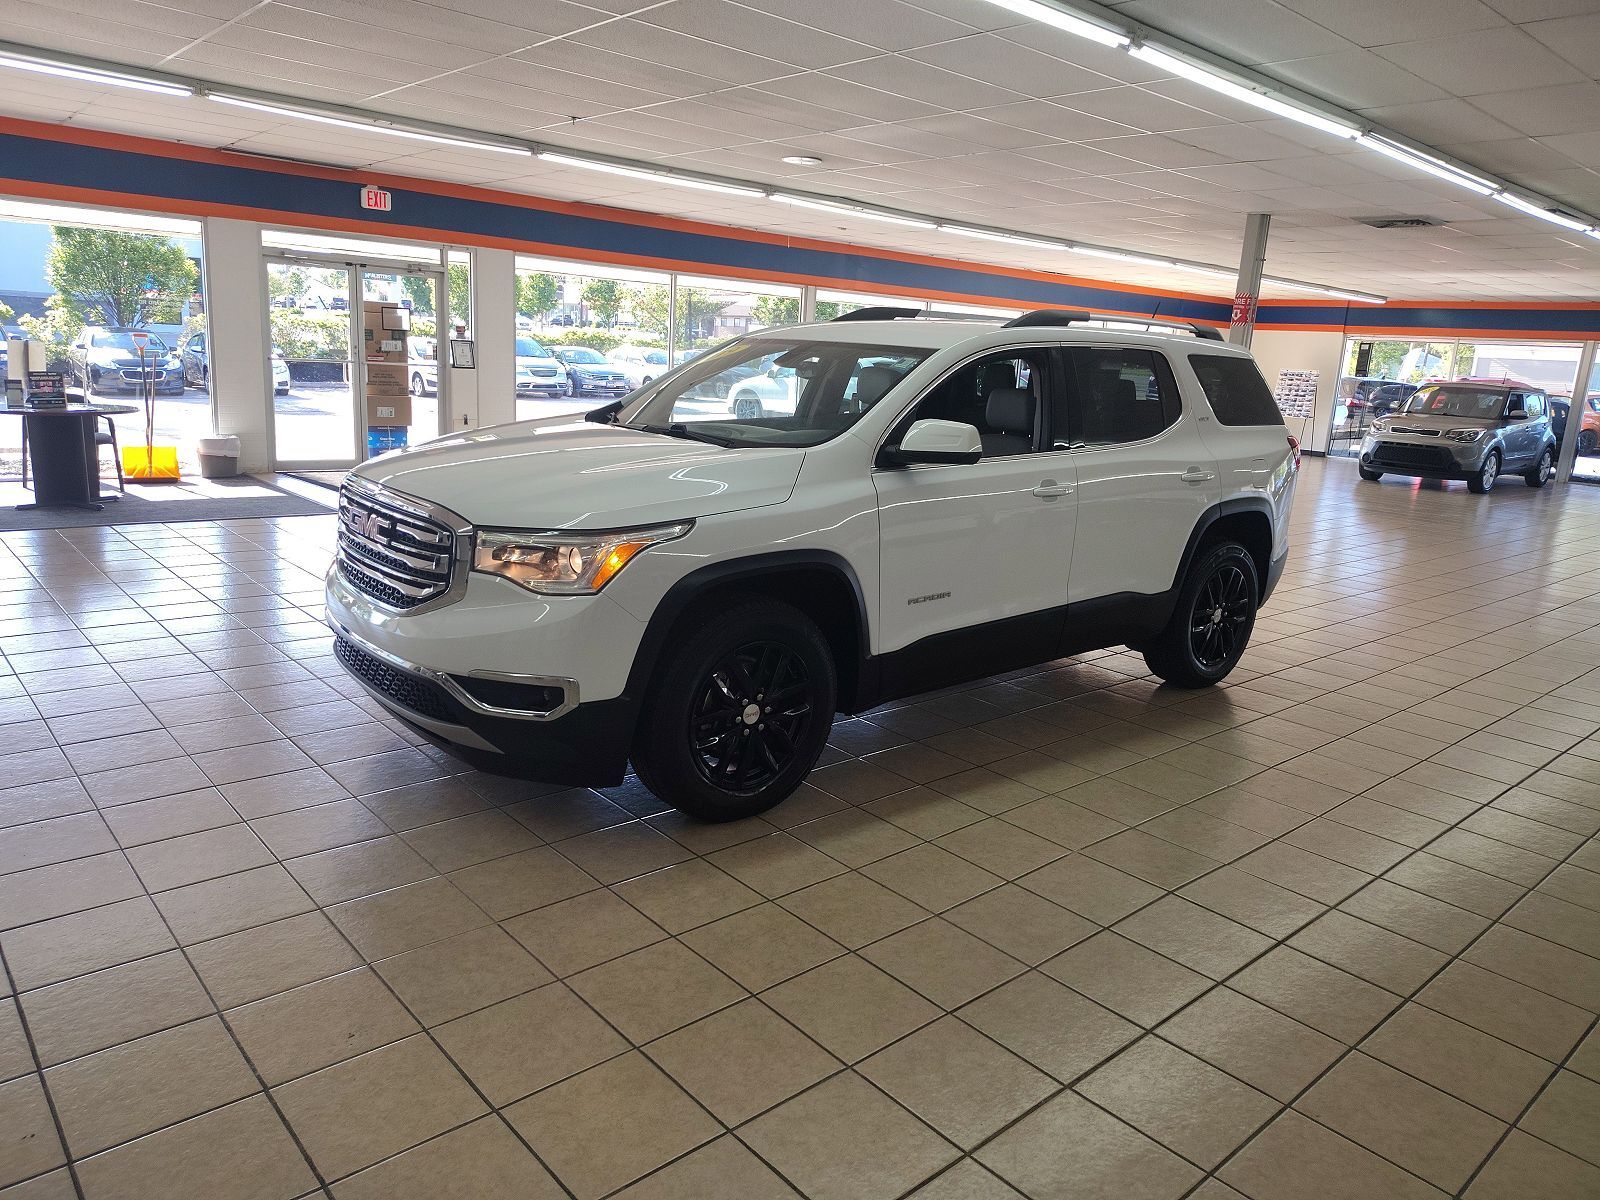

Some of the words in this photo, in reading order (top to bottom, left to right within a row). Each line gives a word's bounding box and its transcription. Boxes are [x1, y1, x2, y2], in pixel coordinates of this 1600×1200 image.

[367, 190, 387, 208] EXIT
[348, 507, 391, 545] GMC
[907, 591, 951, 606] ACADIA
